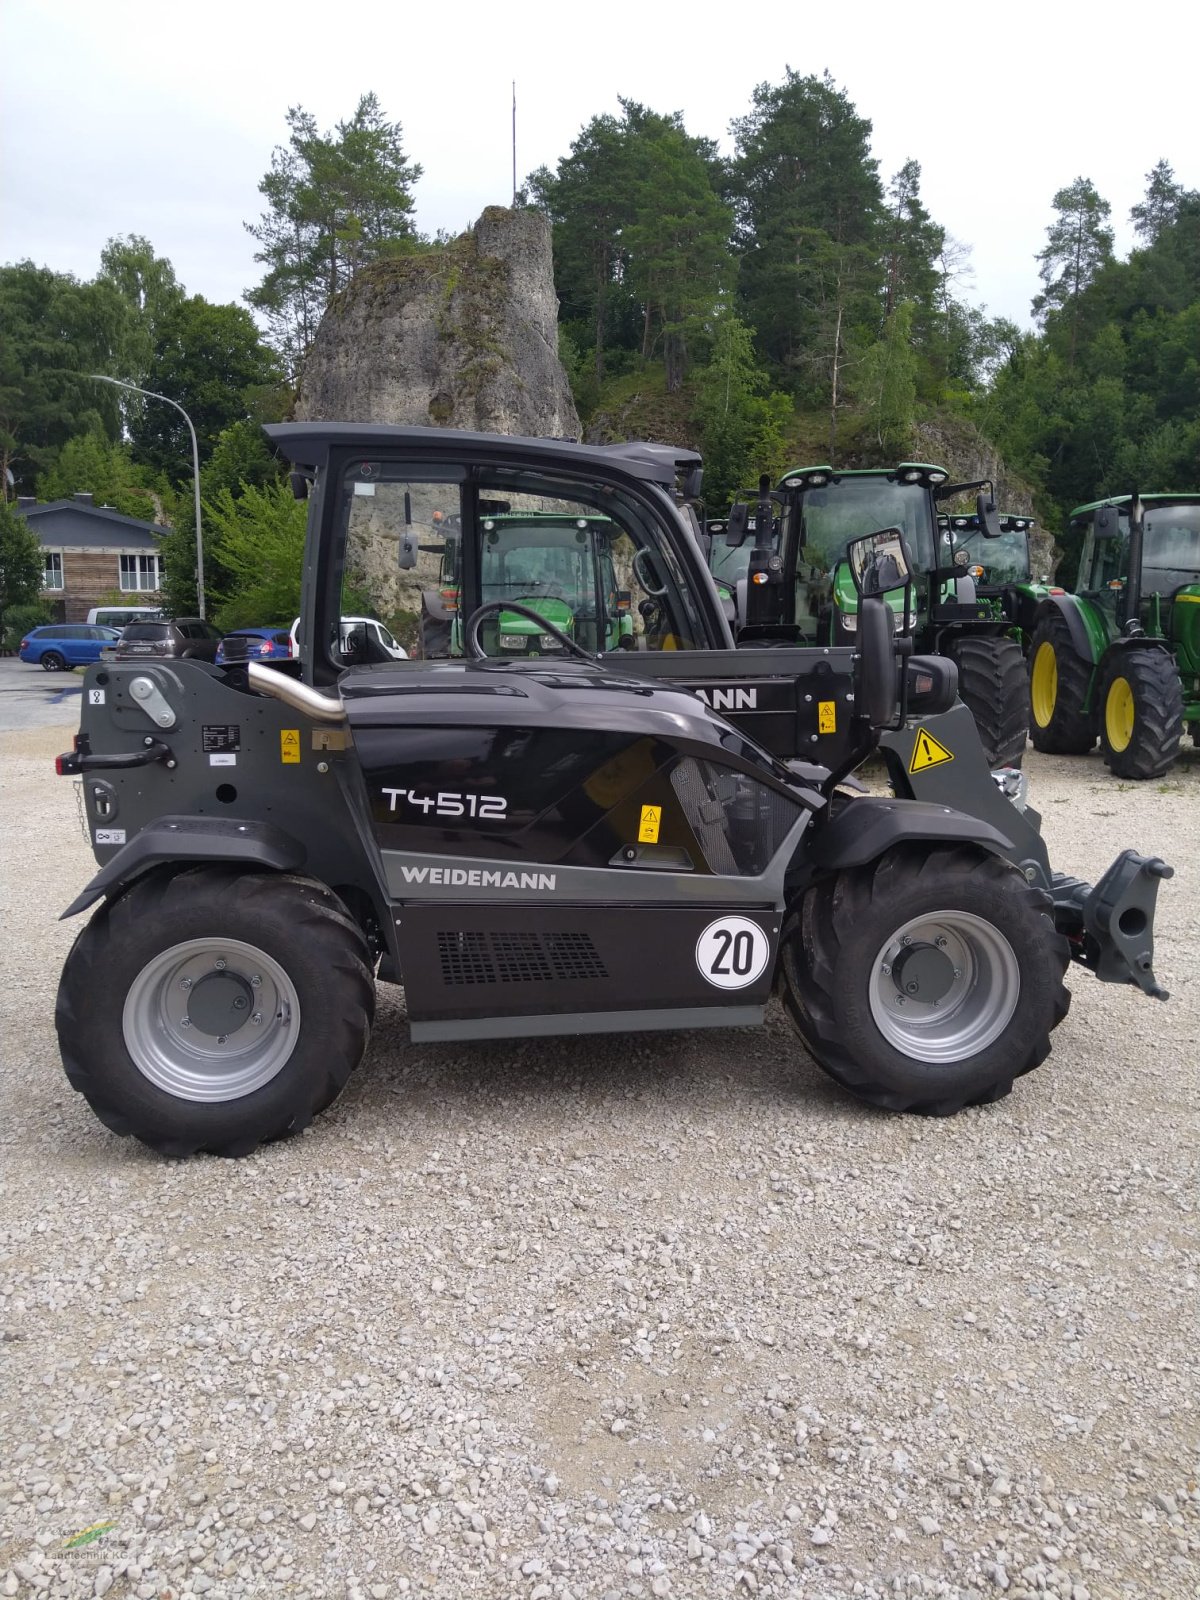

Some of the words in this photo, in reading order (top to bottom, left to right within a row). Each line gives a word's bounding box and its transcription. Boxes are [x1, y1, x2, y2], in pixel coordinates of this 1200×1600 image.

[381, 787, 508, 820] T4512
[400, 866, 556, 891] WEIDEMANN
[711, 929, 754, 976] 20
